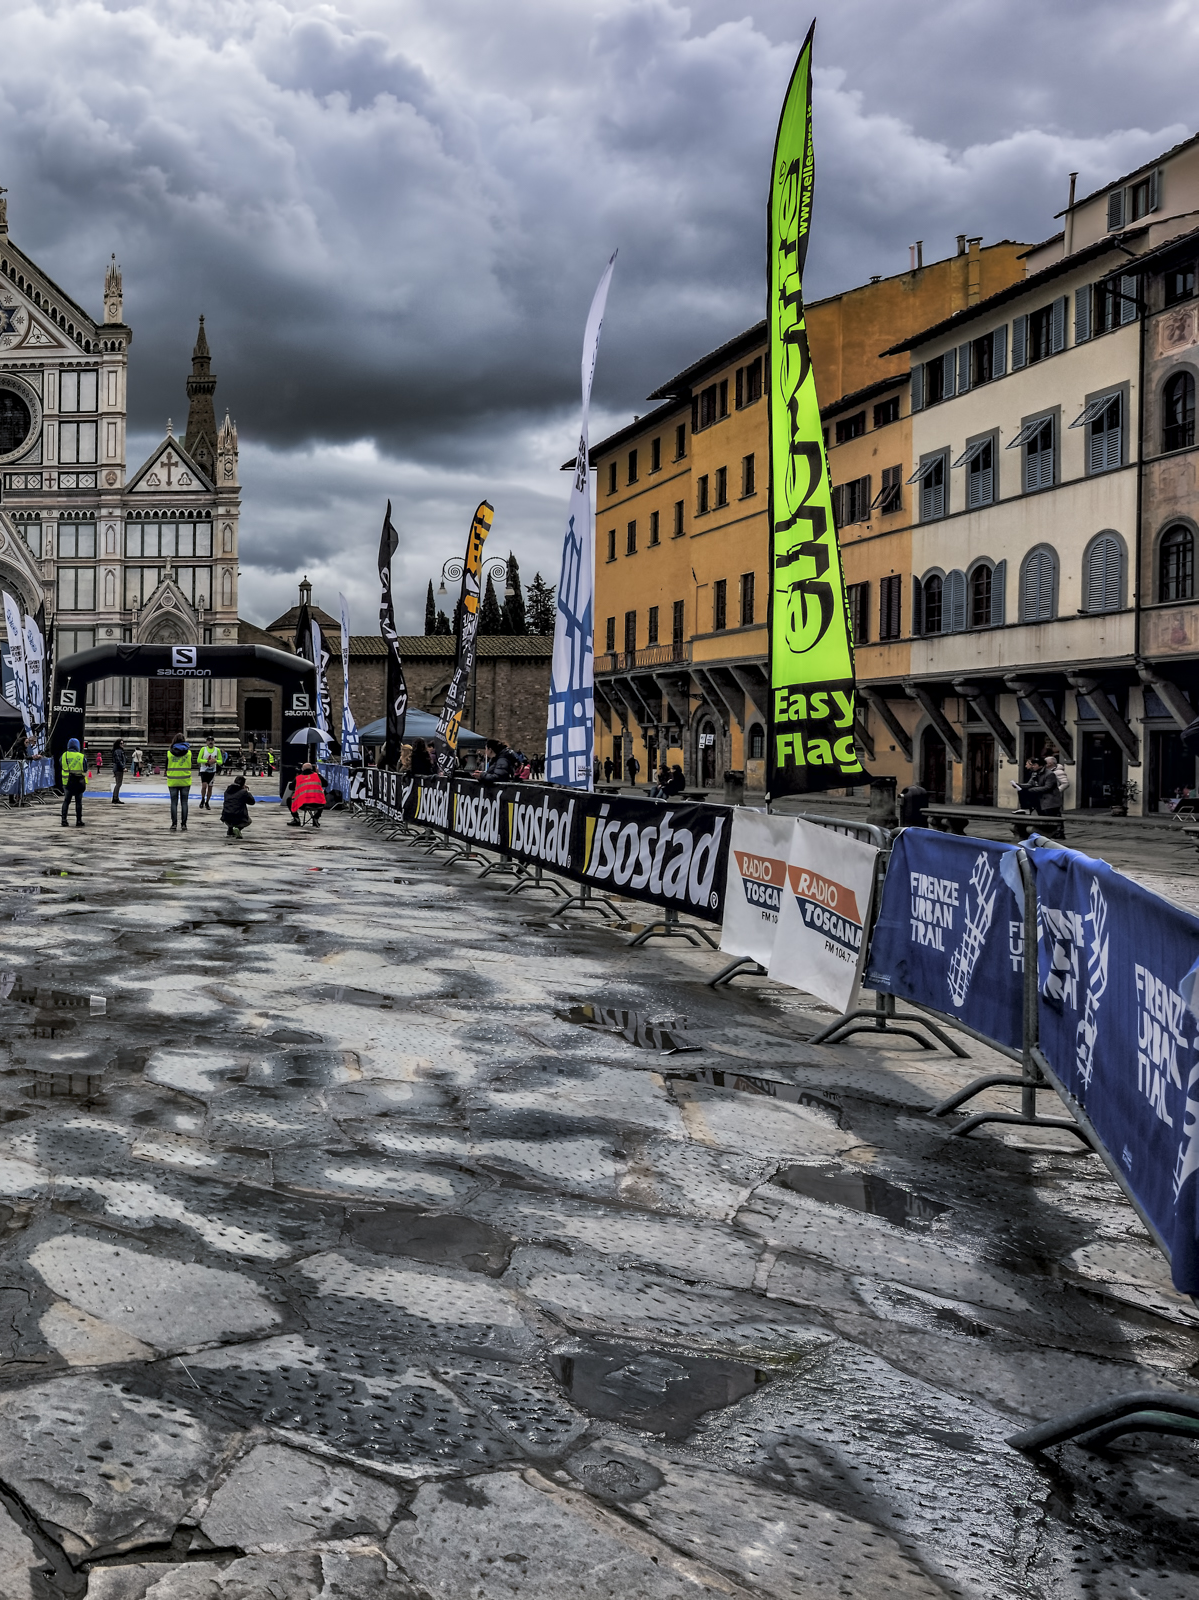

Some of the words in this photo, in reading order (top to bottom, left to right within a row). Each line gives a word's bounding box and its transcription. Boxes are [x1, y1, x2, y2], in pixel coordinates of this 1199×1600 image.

[157, 668, 212, 676] salomon
[54, 705, 83, 713] salomon
[285, 709, 315, 718] salomon
[775, 688, 855, 728] Easy
[455, 786, 502, 845] isostad
[511, 792, 575, 863] isostad
[587, 804, 725, 907] isostad
[743, 856, 772, 881] RADIO
[798, 873, 838, 907] RADIO
[910, 871, 959, 907] FIRENZE
[761, 912, 771, 922] FM
[911, 896, 953, 930] URBAN
[824, 940, 835, 955] FM
[835, 946, 852, 963] 104.7
[910, 919, 945, 952] TRAIL
